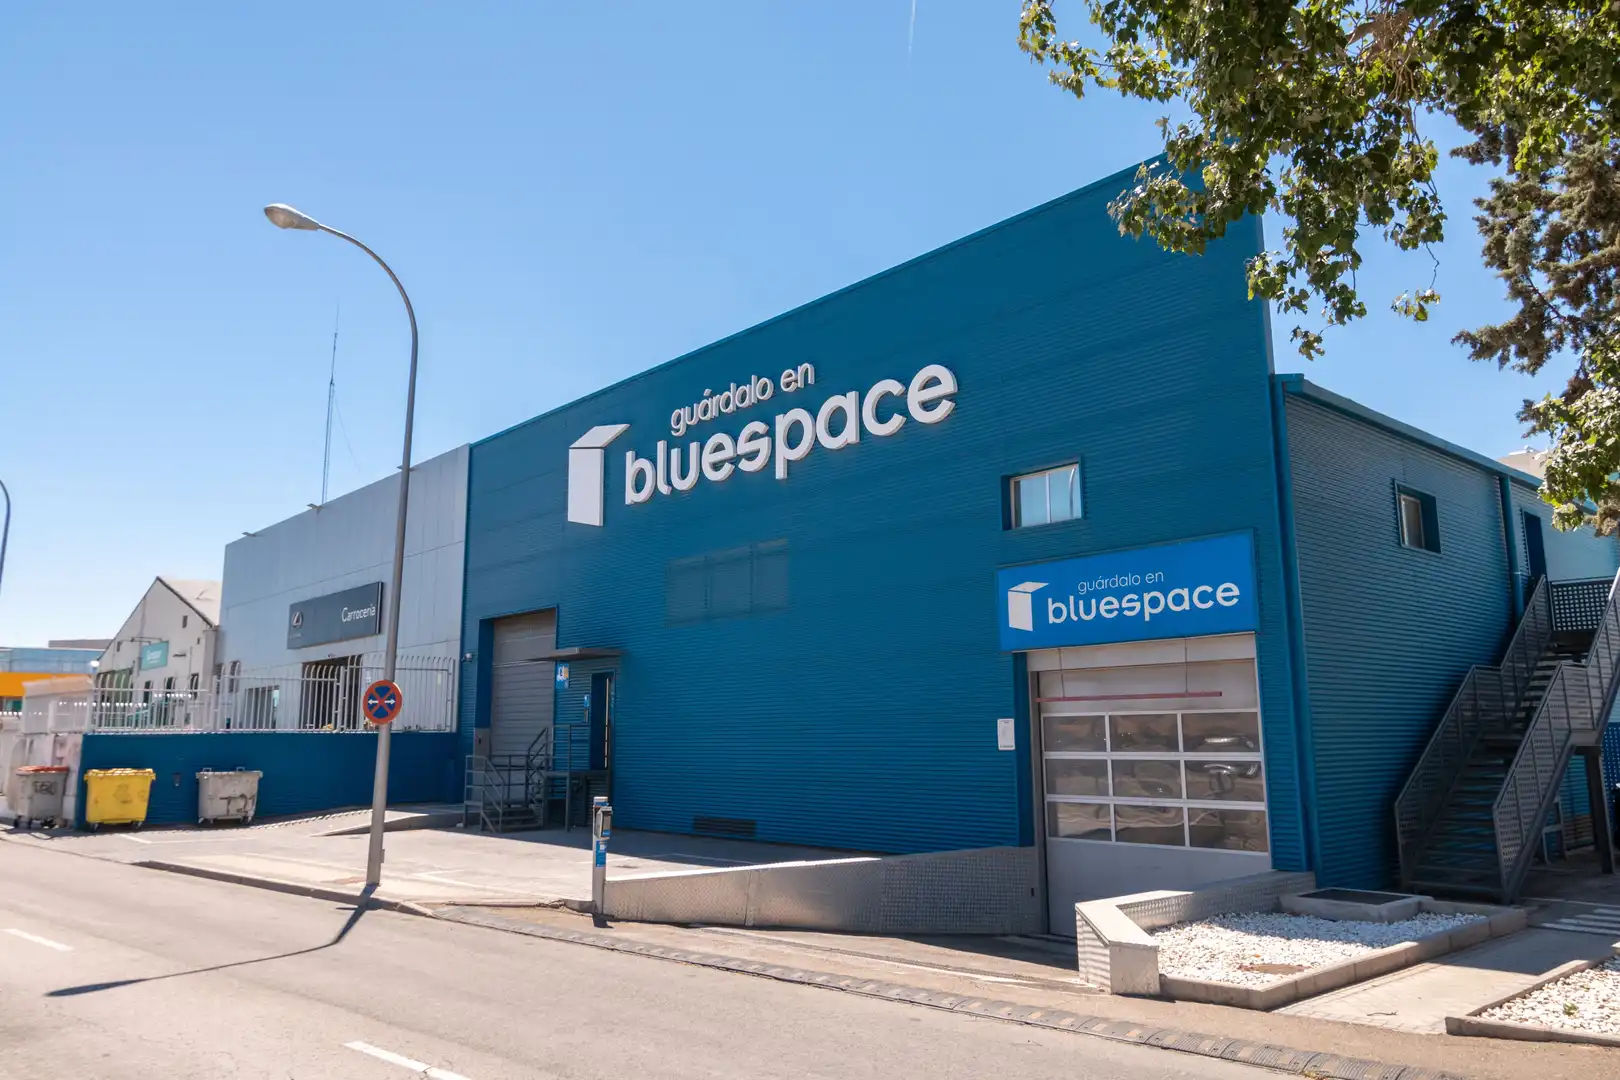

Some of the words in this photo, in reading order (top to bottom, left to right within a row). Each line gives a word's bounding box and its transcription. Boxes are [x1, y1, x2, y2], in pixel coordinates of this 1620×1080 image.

[670, 374, 774, 437] guárdalo
[780, 362, 815, 393] en
[624, 364, 958, 505] bluespace
[1047, 582, 1240, 624] bluespace
[1077, 572, 1141, 595] guárdalo
[1145, 571, 1164, 584] en
